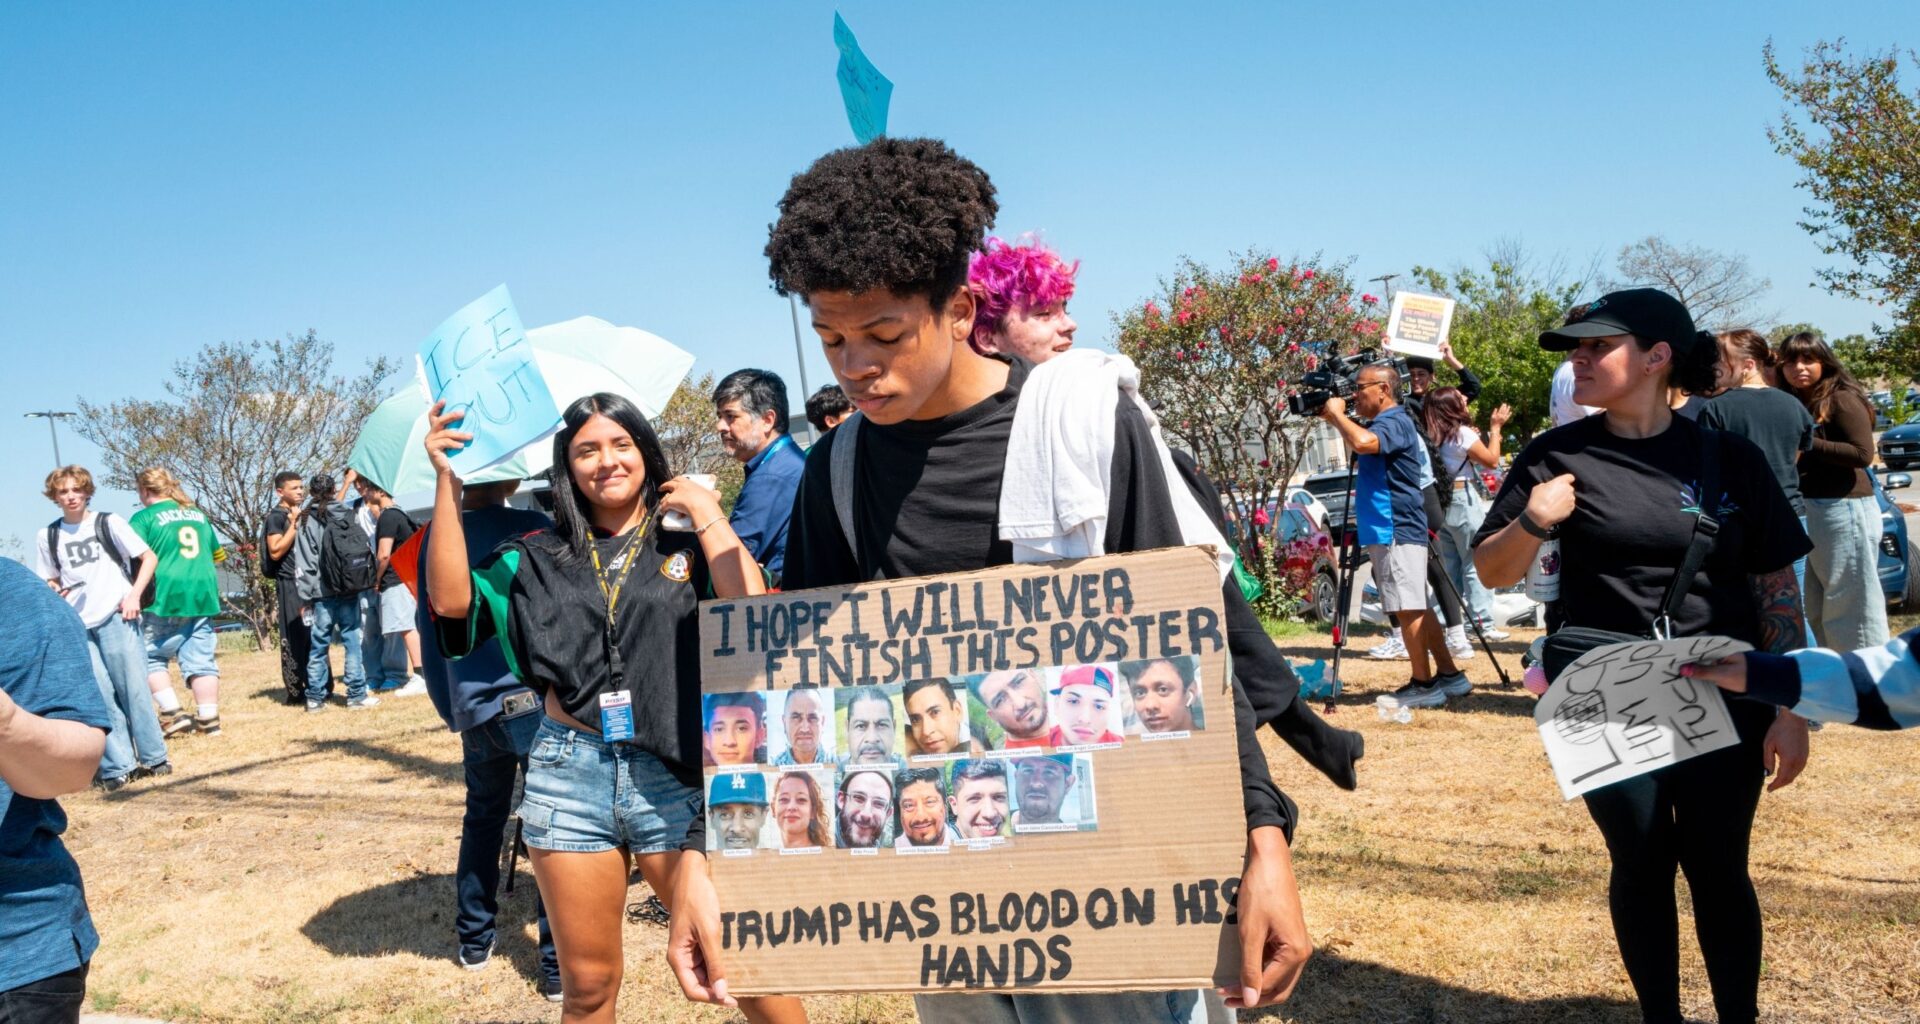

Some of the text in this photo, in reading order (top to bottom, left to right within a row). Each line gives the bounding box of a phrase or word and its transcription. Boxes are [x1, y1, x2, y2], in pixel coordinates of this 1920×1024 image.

[156, 508, 205, 527] JACKSON
[178, 525, 200, 560] 9
[709, 567, 1135, 657] I HOPE I WILL NEVER
[765, 606, 1225, 691] FINISH THIS POSTER
[720, 877, 1242, 952] TRUMP HAS BLOOD ON HIS
[920, 934, 1073, 988] HANDS
